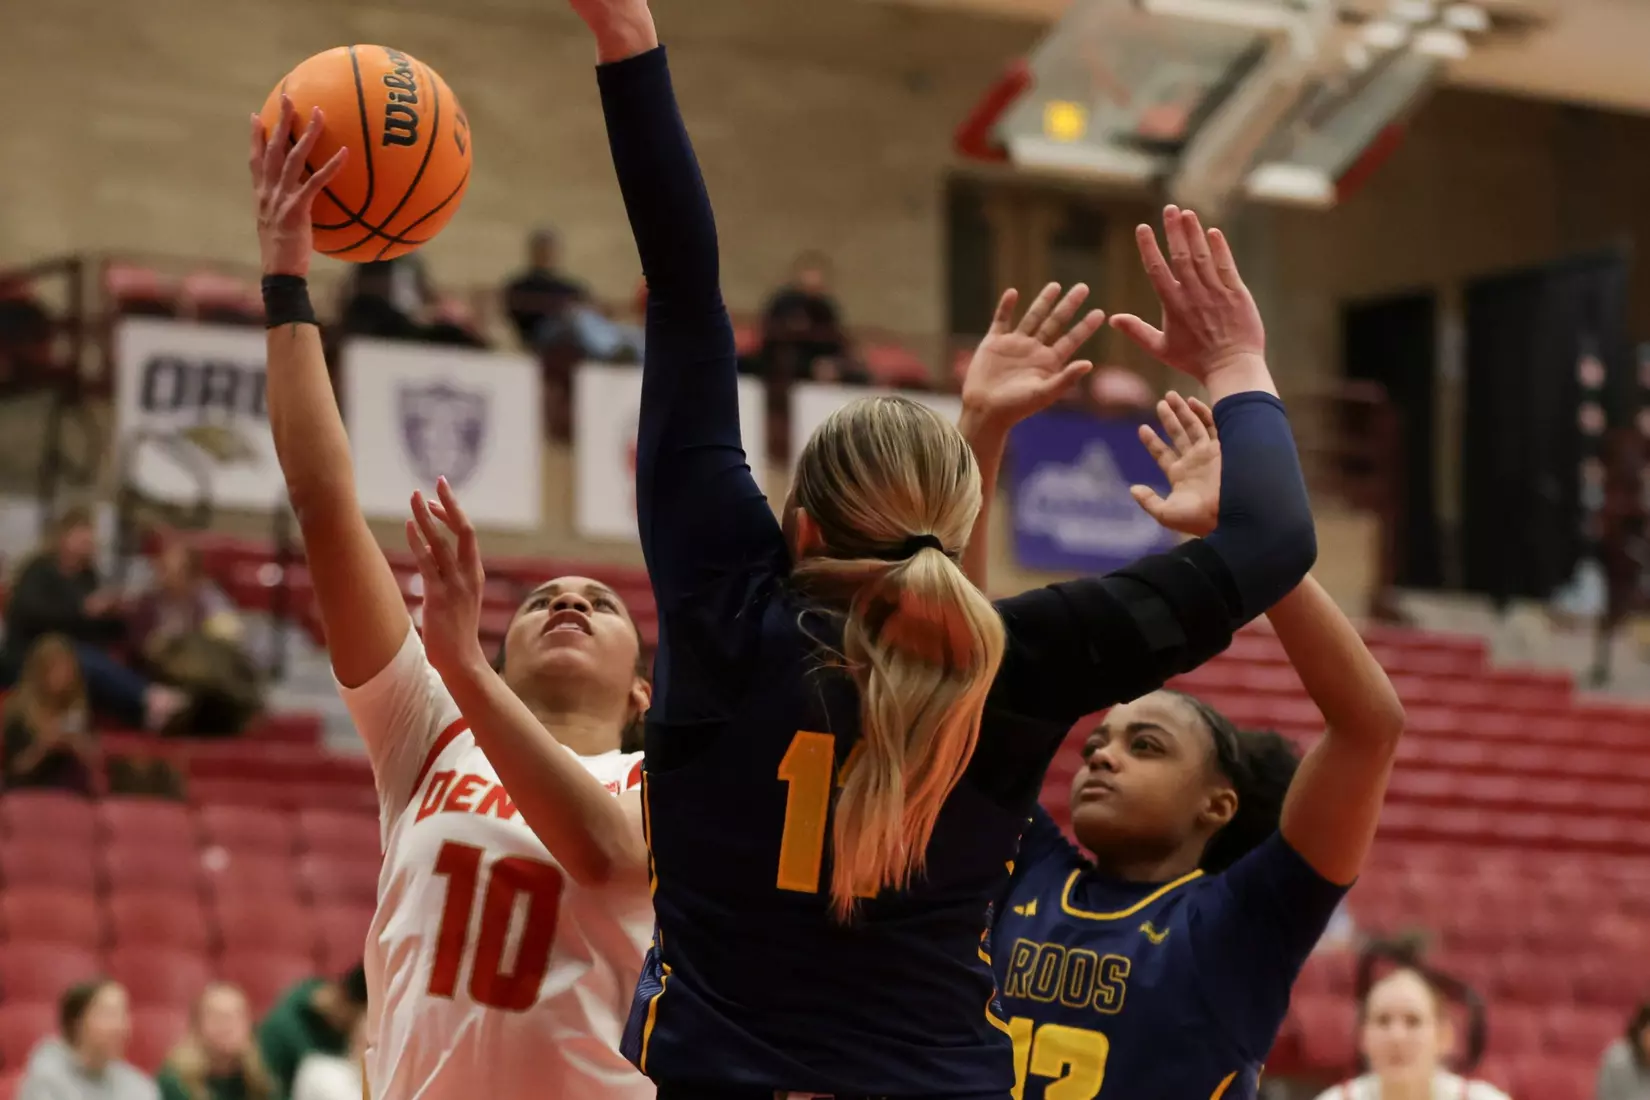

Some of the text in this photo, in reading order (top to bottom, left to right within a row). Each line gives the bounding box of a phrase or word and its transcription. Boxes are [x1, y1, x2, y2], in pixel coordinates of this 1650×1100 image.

[413, 769, 529, 827] DEN
[427, 838, 565, 1014] 10
[1004, 937, 1131, 1014] ROOS
